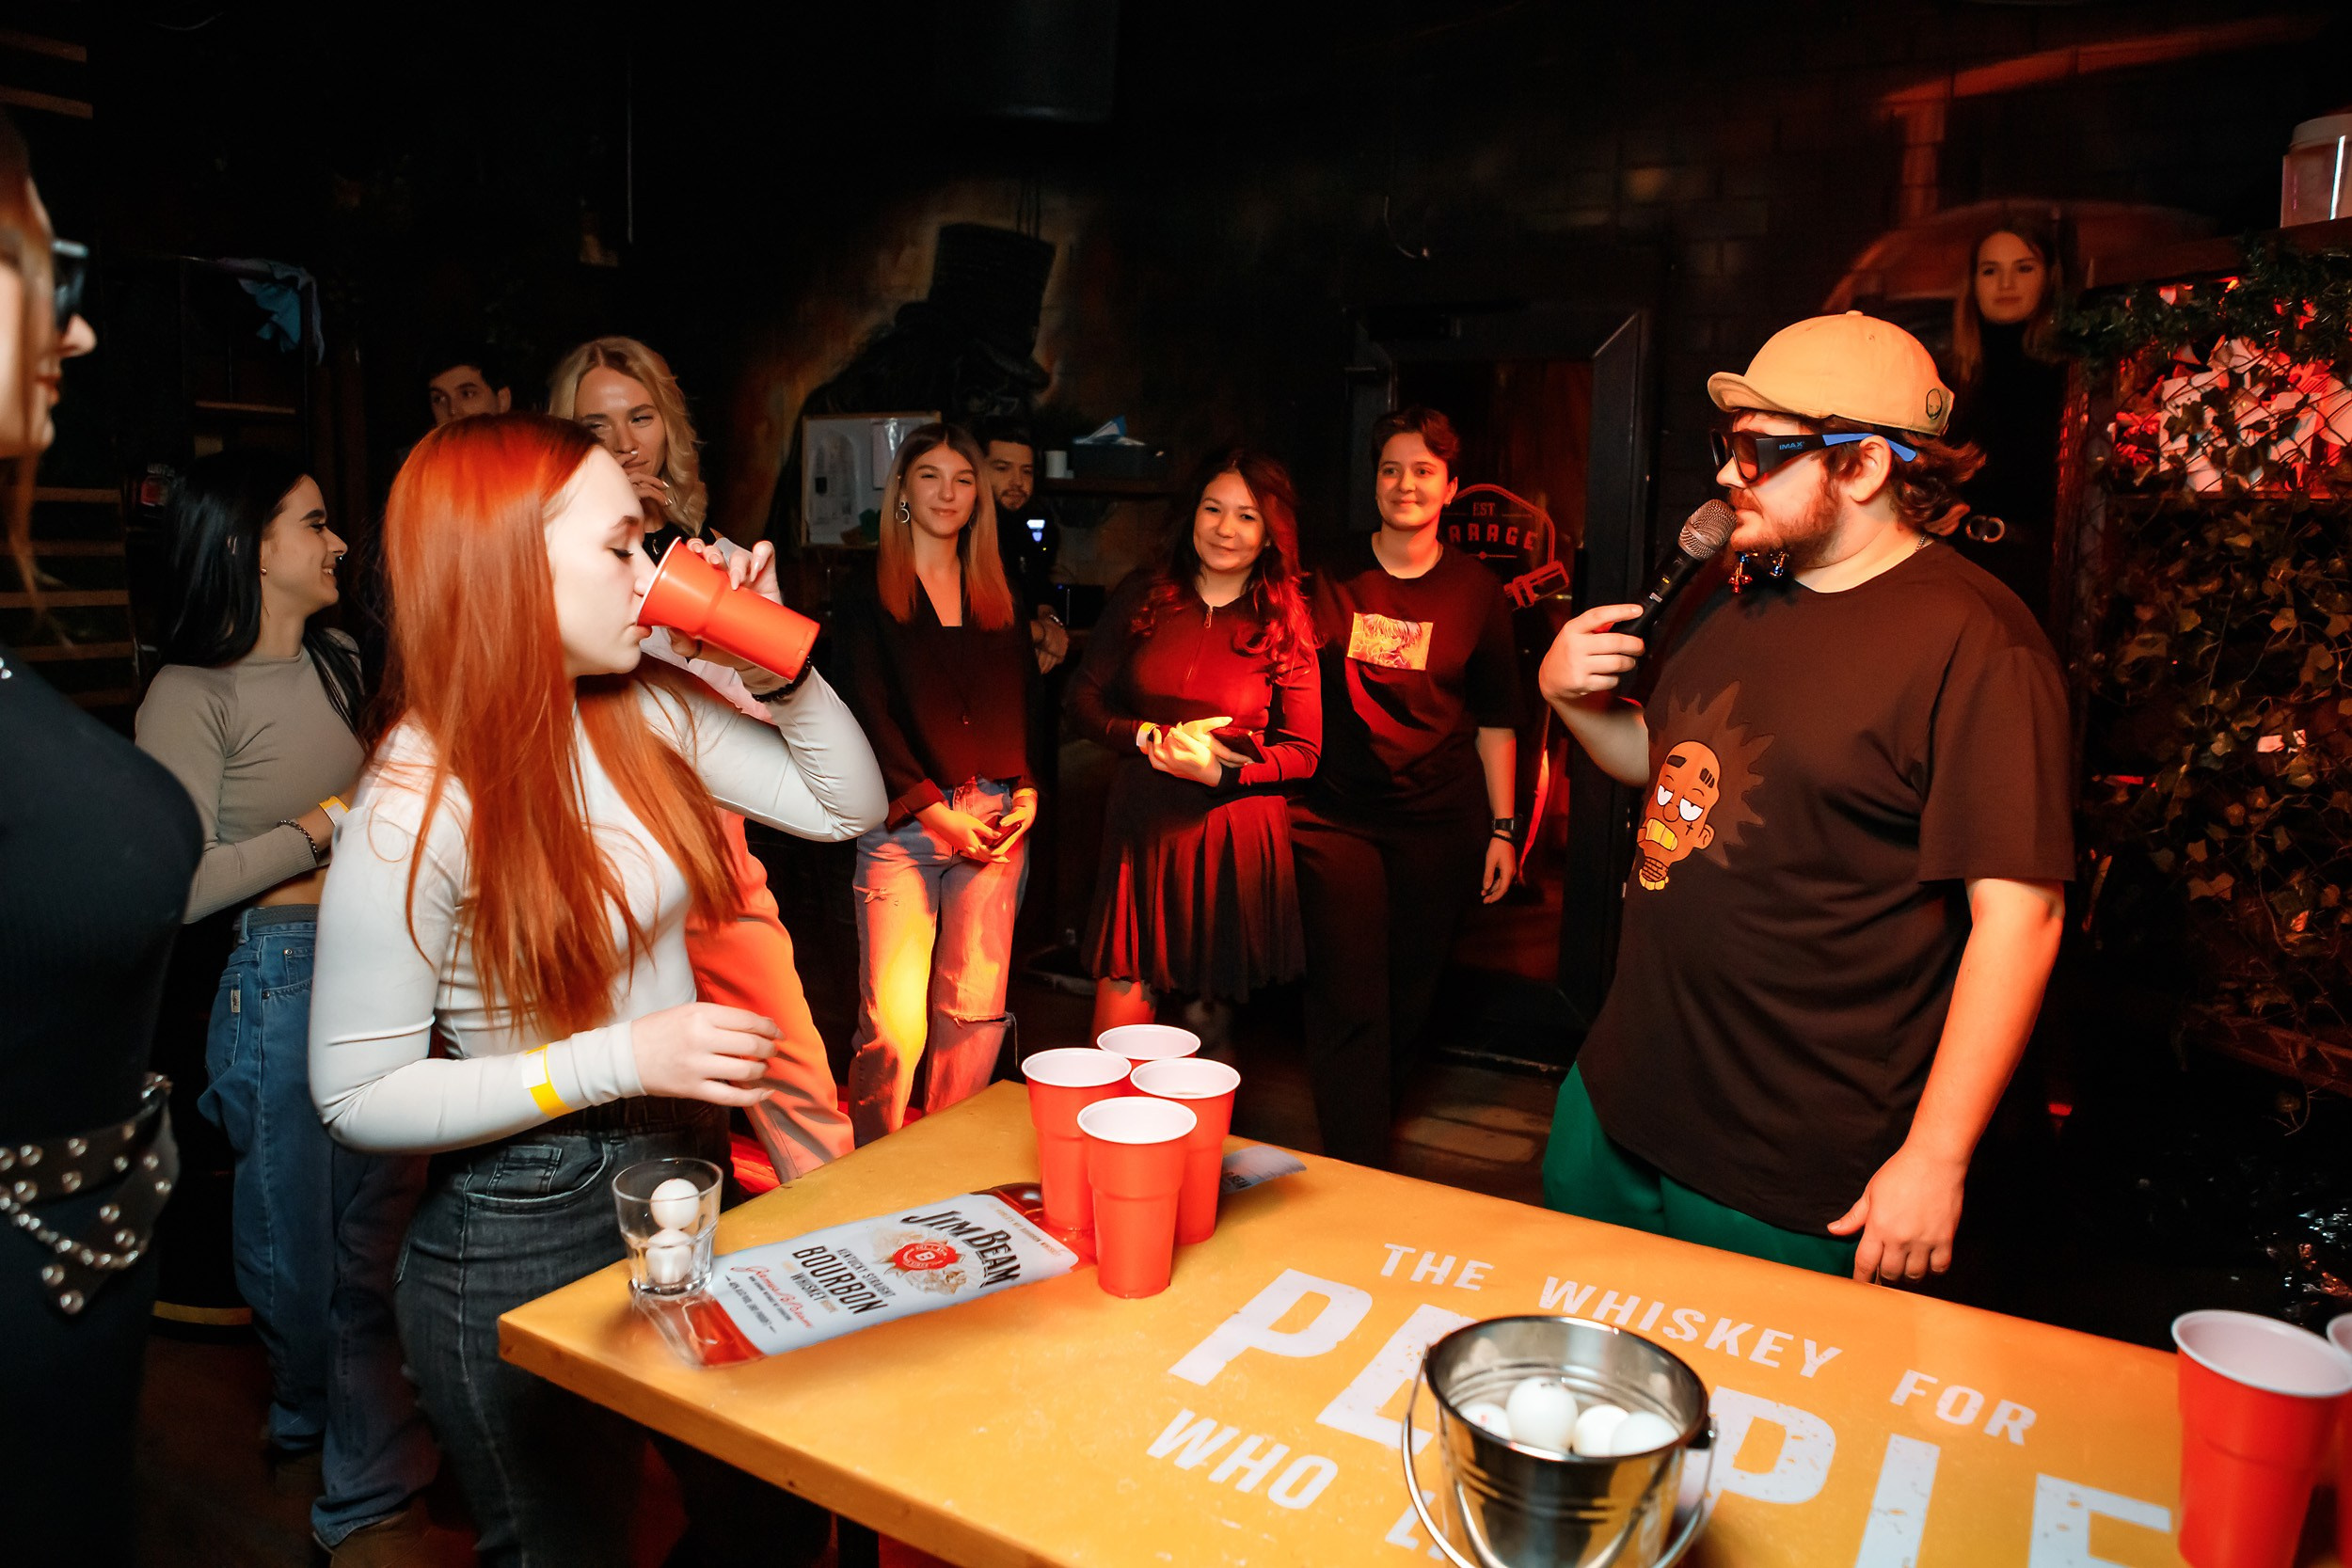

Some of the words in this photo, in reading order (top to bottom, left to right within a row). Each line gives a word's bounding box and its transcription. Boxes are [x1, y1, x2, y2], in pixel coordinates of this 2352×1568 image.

[1779, 441, 1803, 451] IMAX
[1448, 523, 1537, 551] ARAGE
[791, 1245, 889, 1315] BOURBON
[900, 1211, 986, 1239] JIM
[961, 1229, 1022, 1289] BEAM
[915, 1251, 936, 1261] B
[790, 1272, 828, 1302] WHISKEY
[1380, 1243, 1496, 1291] THE
[1538, 1275, 1843, 1379] WHISKEY
[1890, 1369, 2038, 1447] FOR
[1167, 1267, 2172, 1568] PEPLE
[1145, 1407, 1339, 1510] WHO
